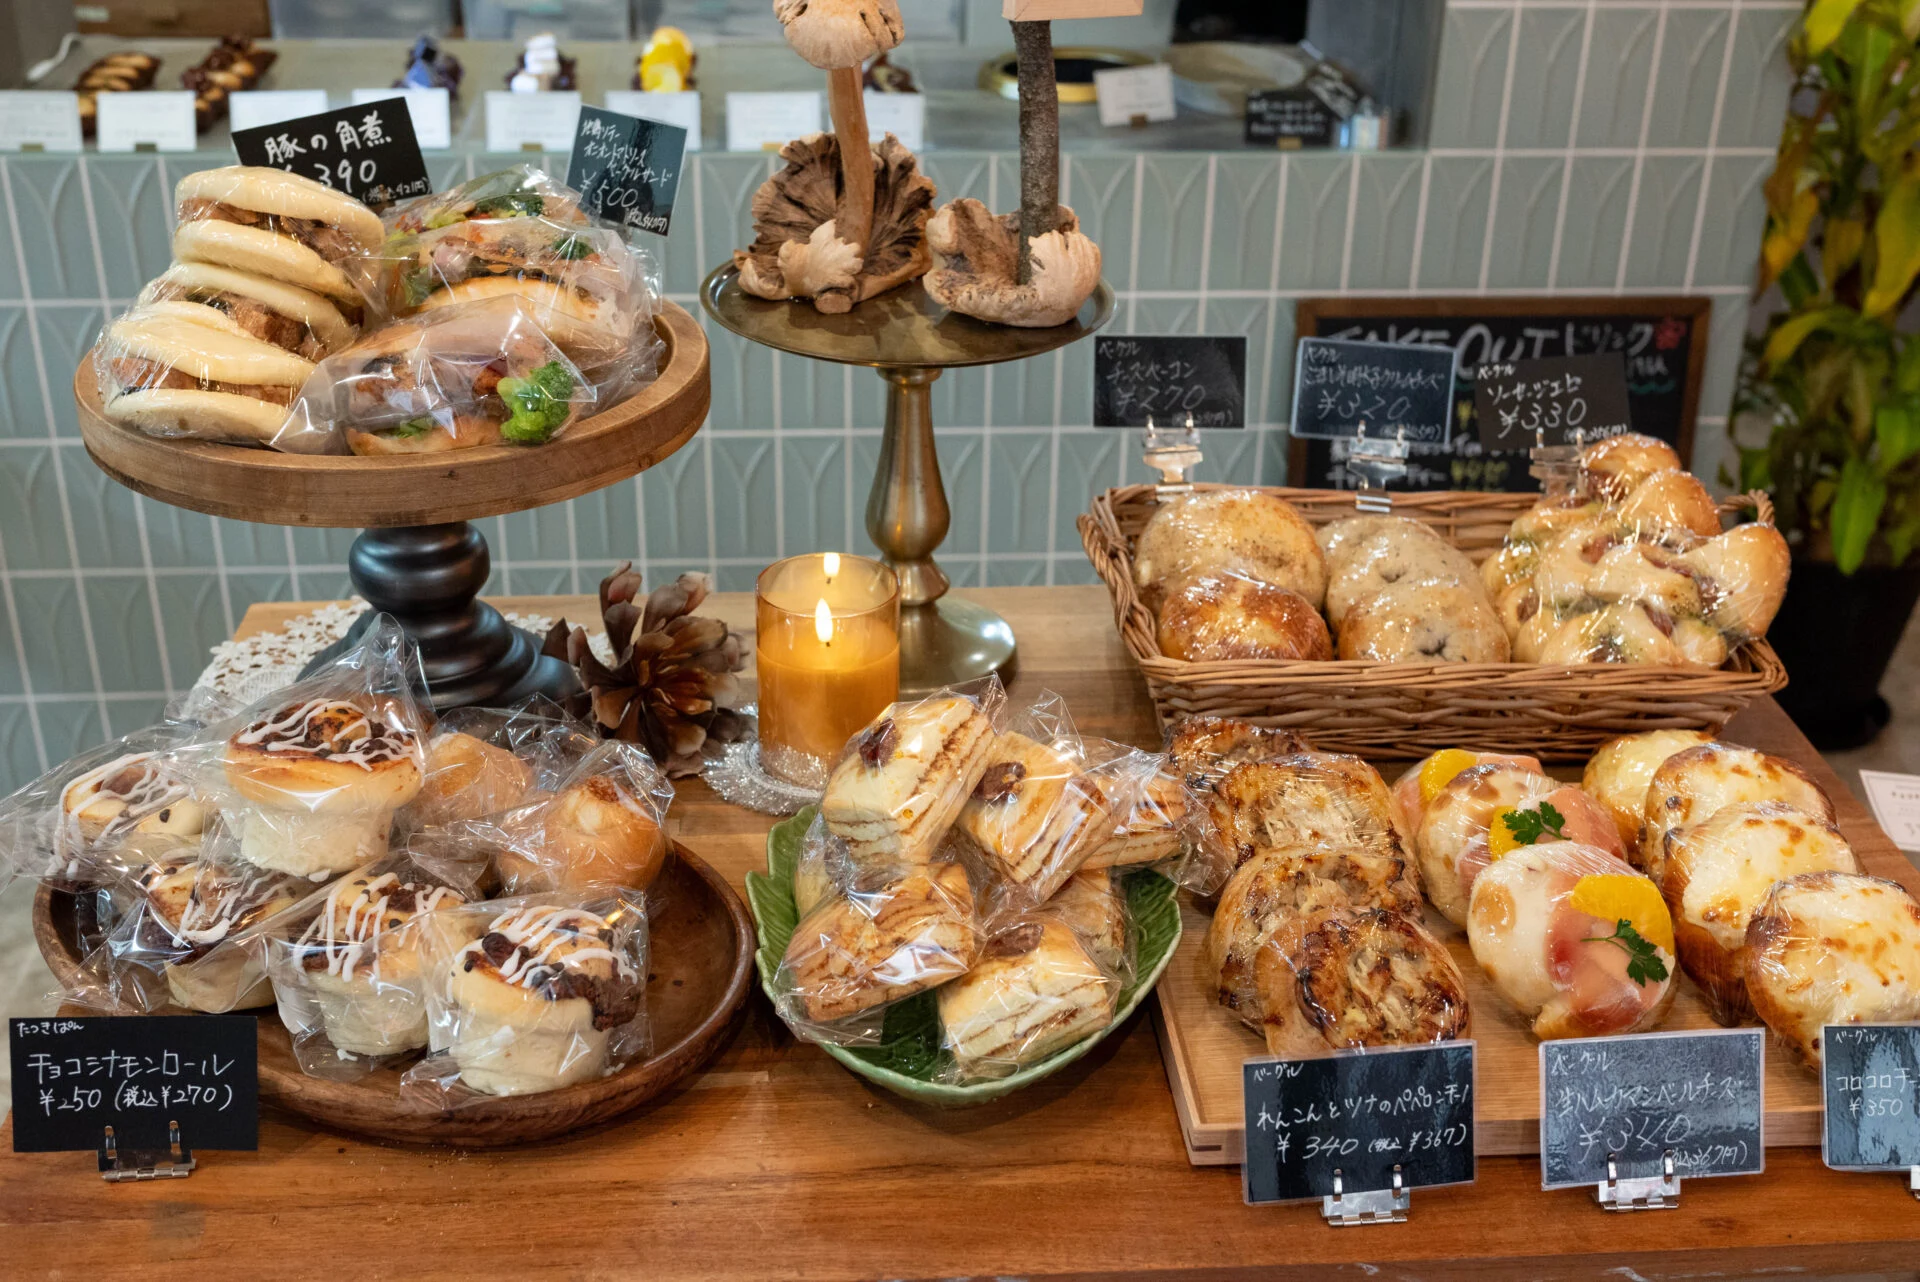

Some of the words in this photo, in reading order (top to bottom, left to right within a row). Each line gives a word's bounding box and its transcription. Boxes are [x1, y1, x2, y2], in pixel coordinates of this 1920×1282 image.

[264, 110, 392, 164] 豚の角煮
[1497, 398, 1588, 439] ¥330
[1835, 1029, 1878, 1045] ベーグル
[27, 1049, 235, 1084] チョコシナモンロール
[1254, 1063, 1303, 1081] ベーグル
[1551, 1051, 1615, 1075] ベーグル
[1836, 1067, 1920, 1094] コロコロチー
